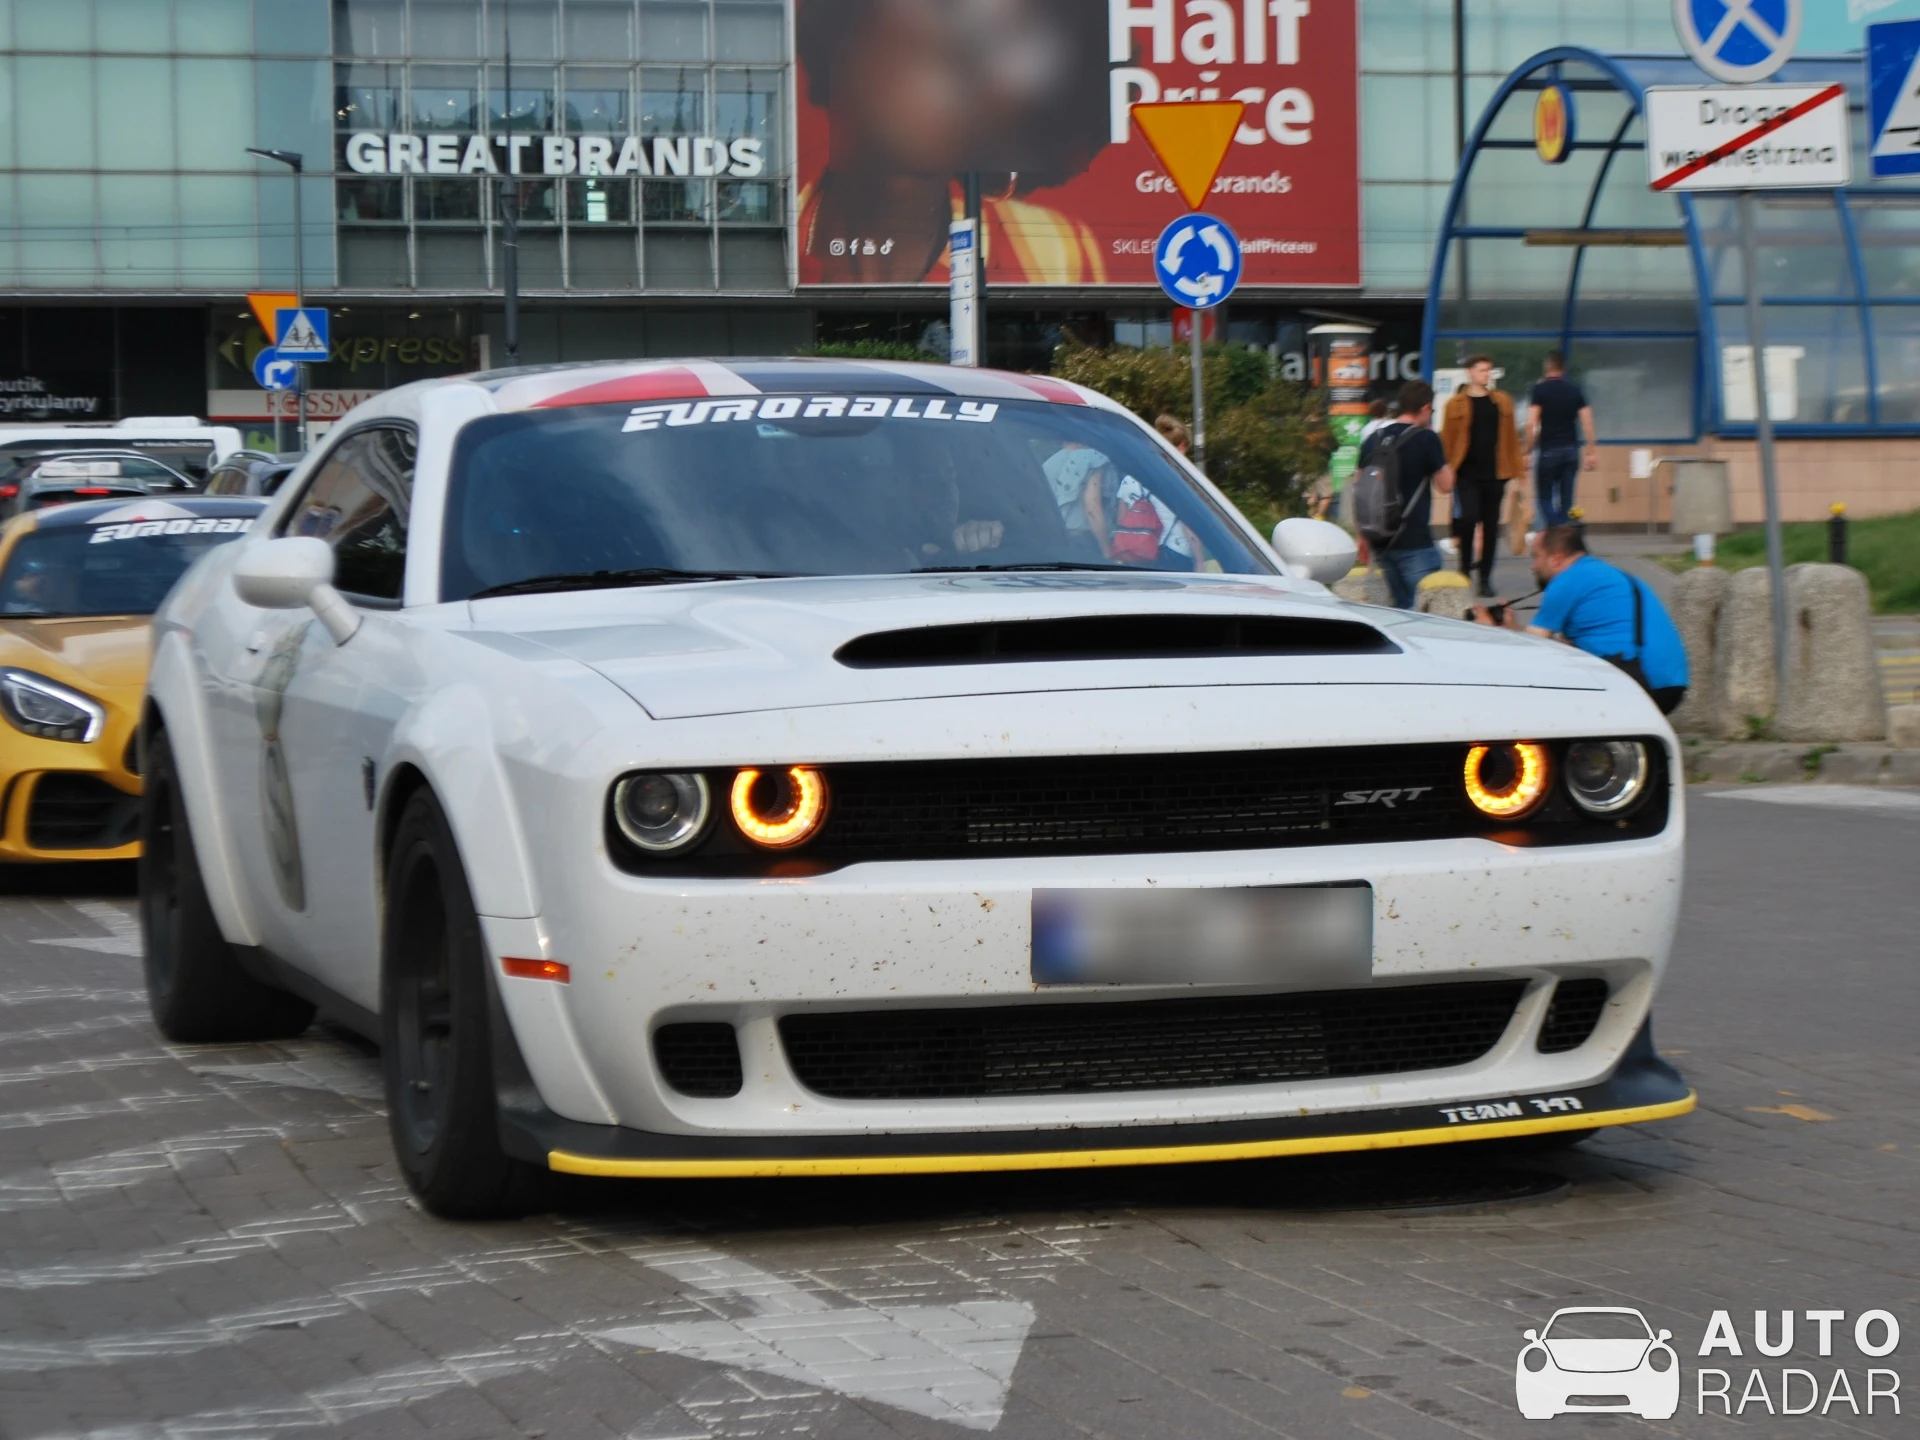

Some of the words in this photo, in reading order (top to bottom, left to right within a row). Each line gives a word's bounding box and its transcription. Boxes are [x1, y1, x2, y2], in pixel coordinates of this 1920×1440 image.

[1109, 0, 1311, 65] Half
[1110, 67, 1315, 146] Pce
[1700, 98, 1792, 132] Droga
[346, 133, 531, 175] GREAT
[543, 137, 763, 178] BRANDS
[1135, 170, 1179, 193] Gre
[330, 335, 465, 372] xpress
[621, 397, 999, 433] EURORALLY
[1334, 786, 1433, 808] SRT
[1438, 1101, 1524, 1123] TEAM
